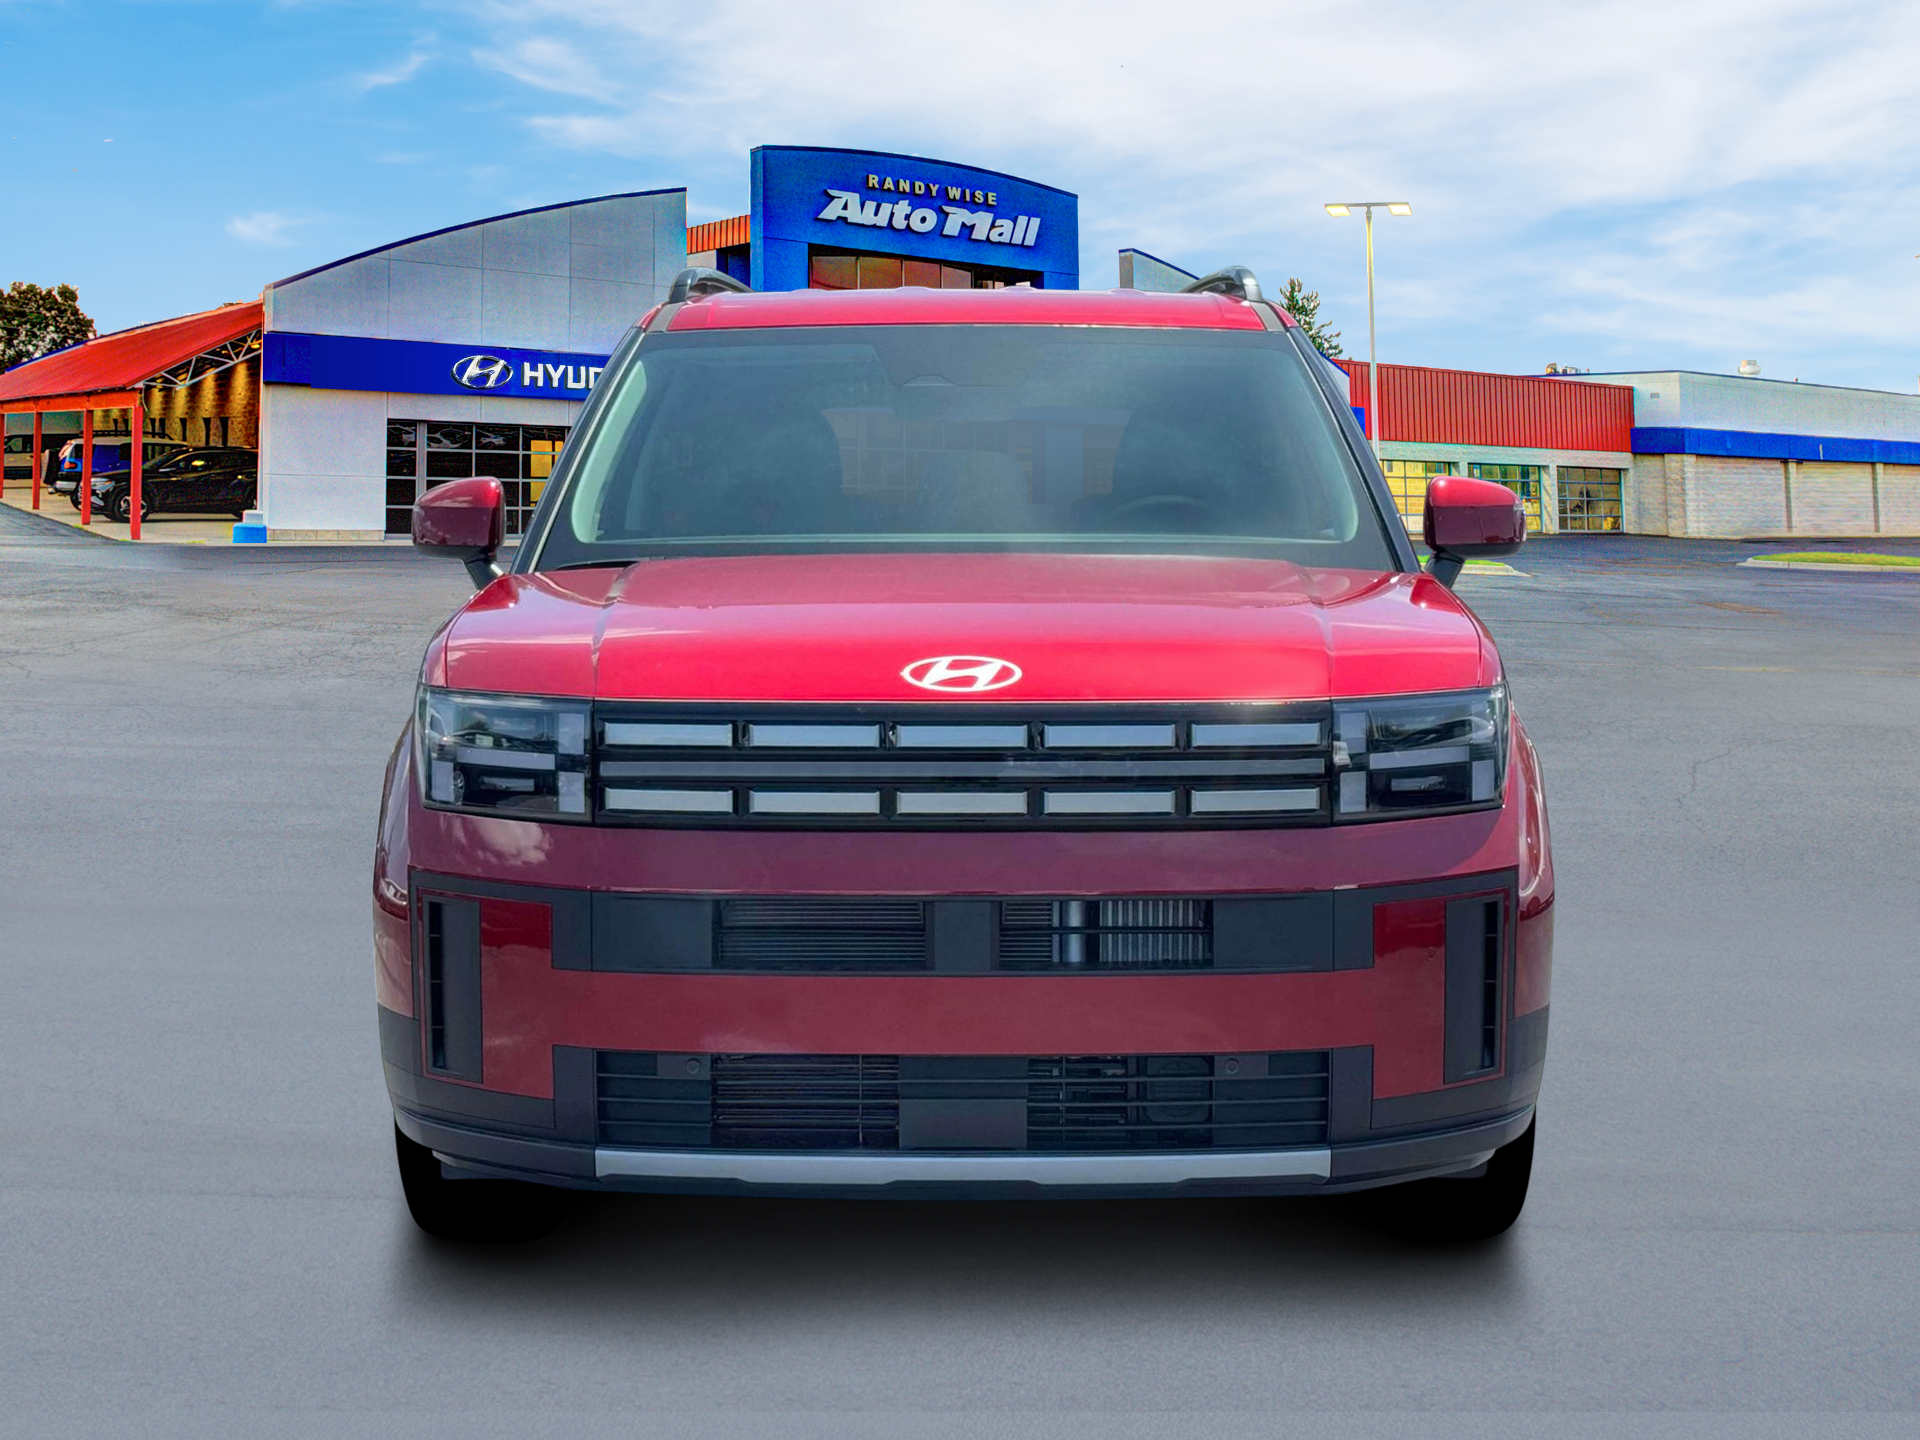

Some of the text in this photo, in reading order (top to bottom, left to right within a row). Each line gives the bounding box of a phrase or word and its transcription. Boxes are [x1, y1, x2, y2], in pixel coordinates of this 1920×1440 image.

[867, 173, 998, 206] RANDY WISE
[817, 188, 1041, 247] Auto Mall
